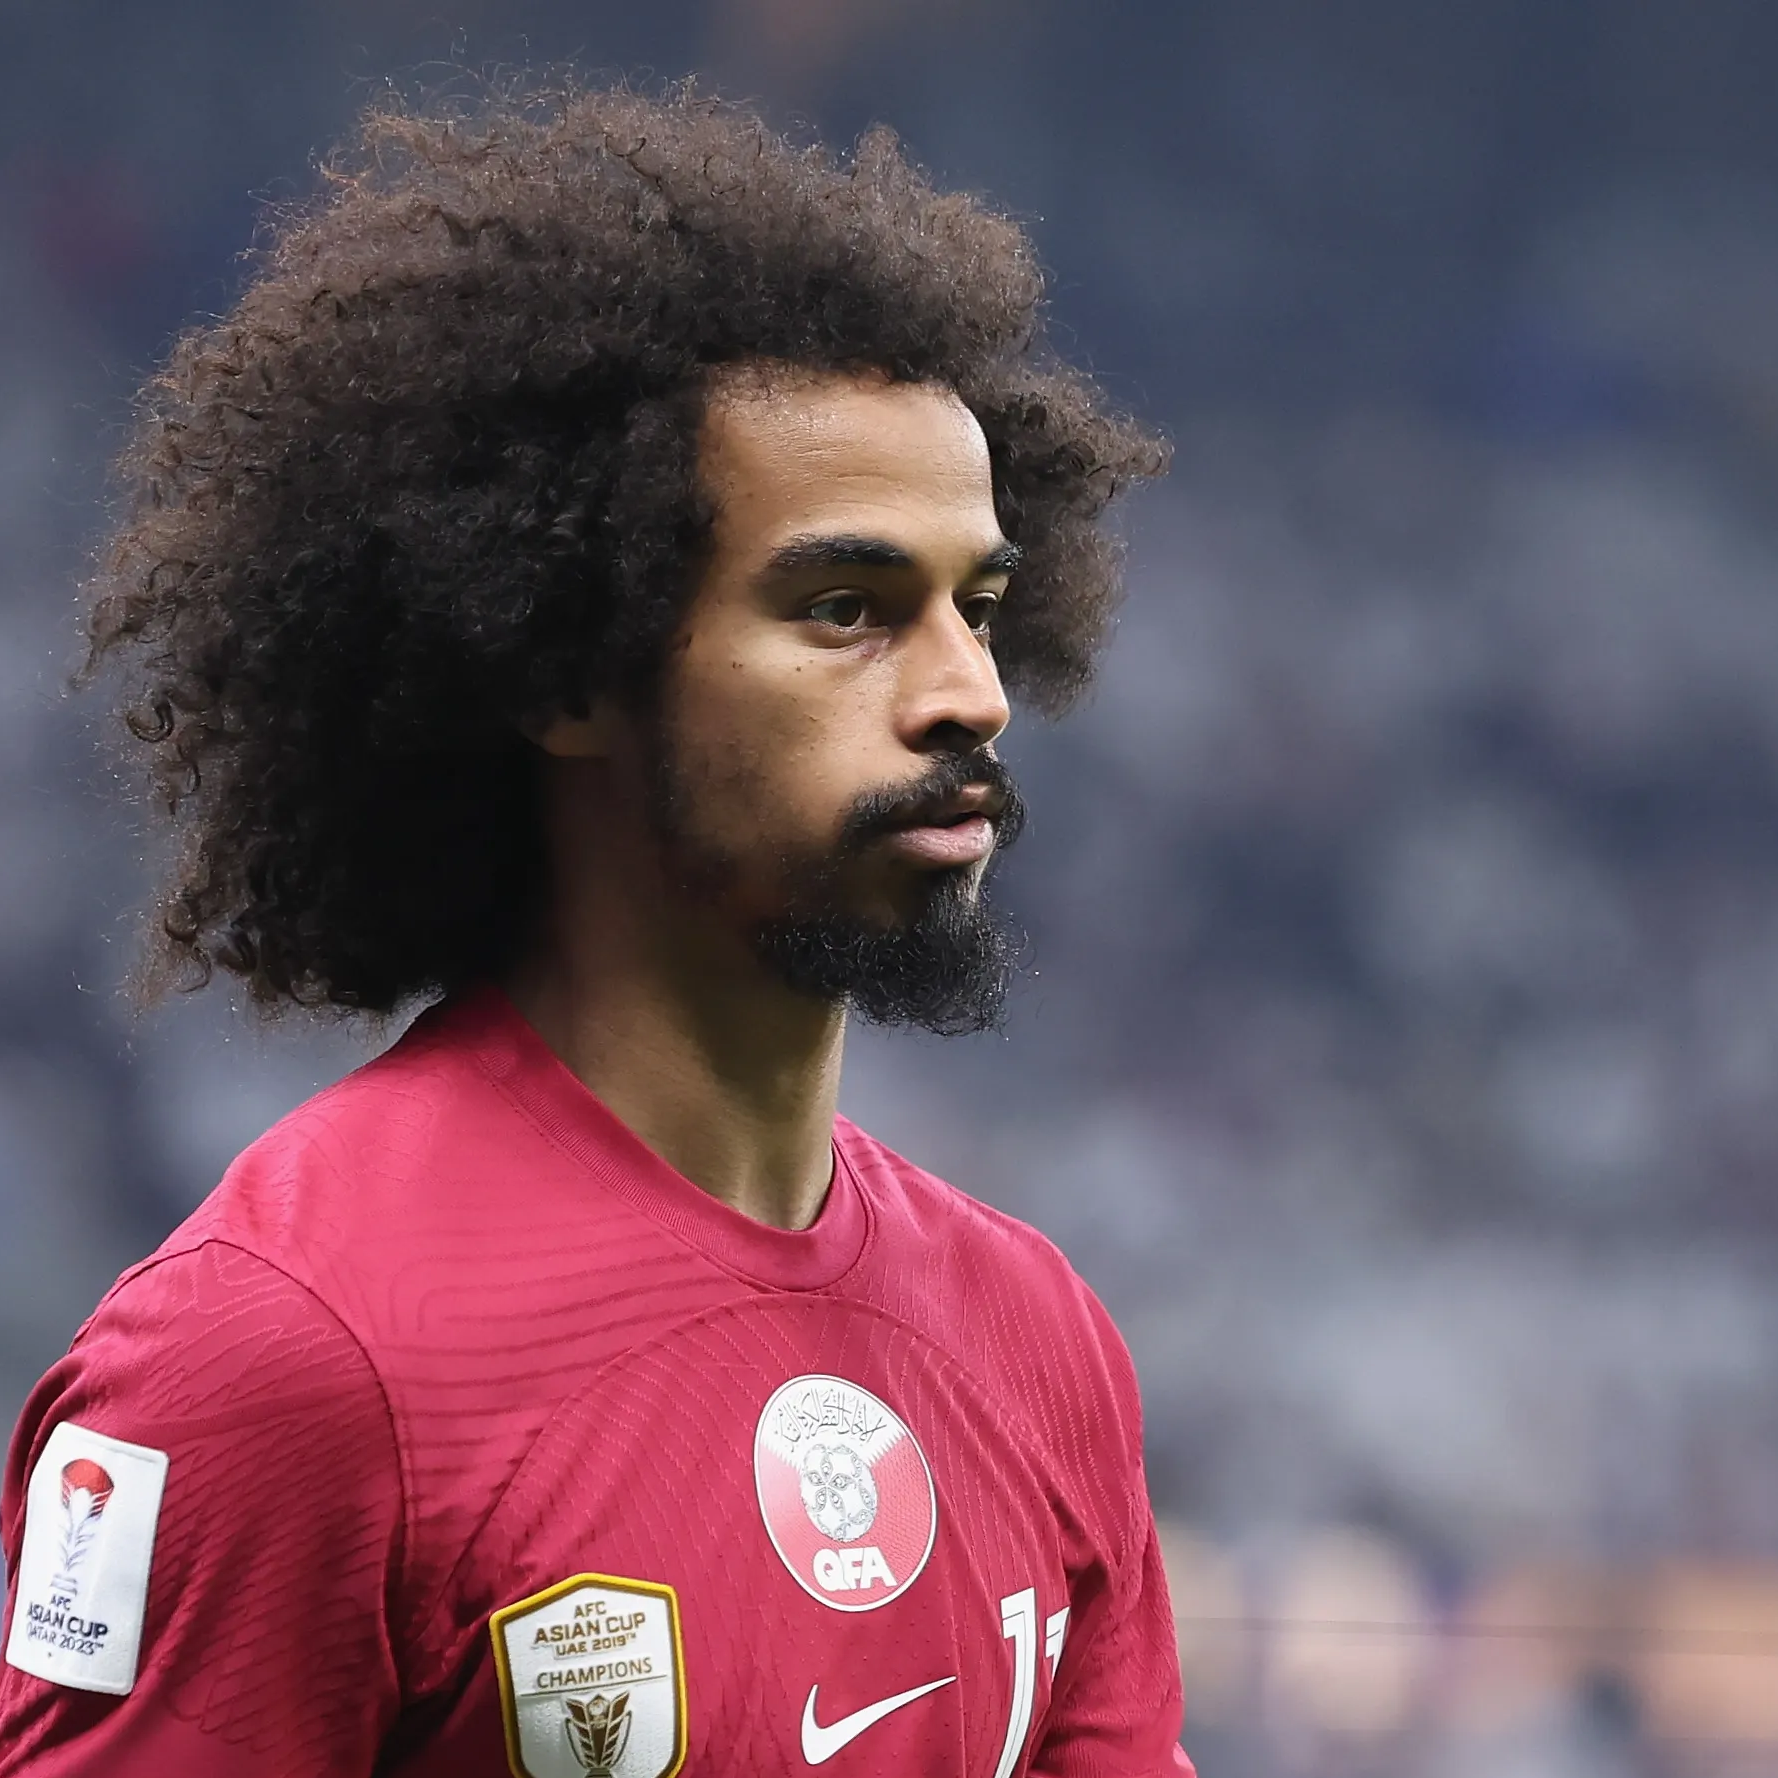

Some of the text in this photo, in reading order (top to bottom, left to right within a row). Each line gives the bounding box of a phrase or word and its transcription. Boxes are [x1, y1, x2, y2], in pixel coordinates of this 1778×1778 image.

[813, 1546, 897, 1592] QFA
[50, 1594, 71, 1611] AFC
[574, 1601, 607, 1619] AFC
[26, 1601, 108, 1639] ASIAN CUP
[534, 1612, 646, 1645] ASIAN CUP
[556, 1641, 587, 1656] UAE
[537, 1657, 653, 1689] CHAMPIONS
